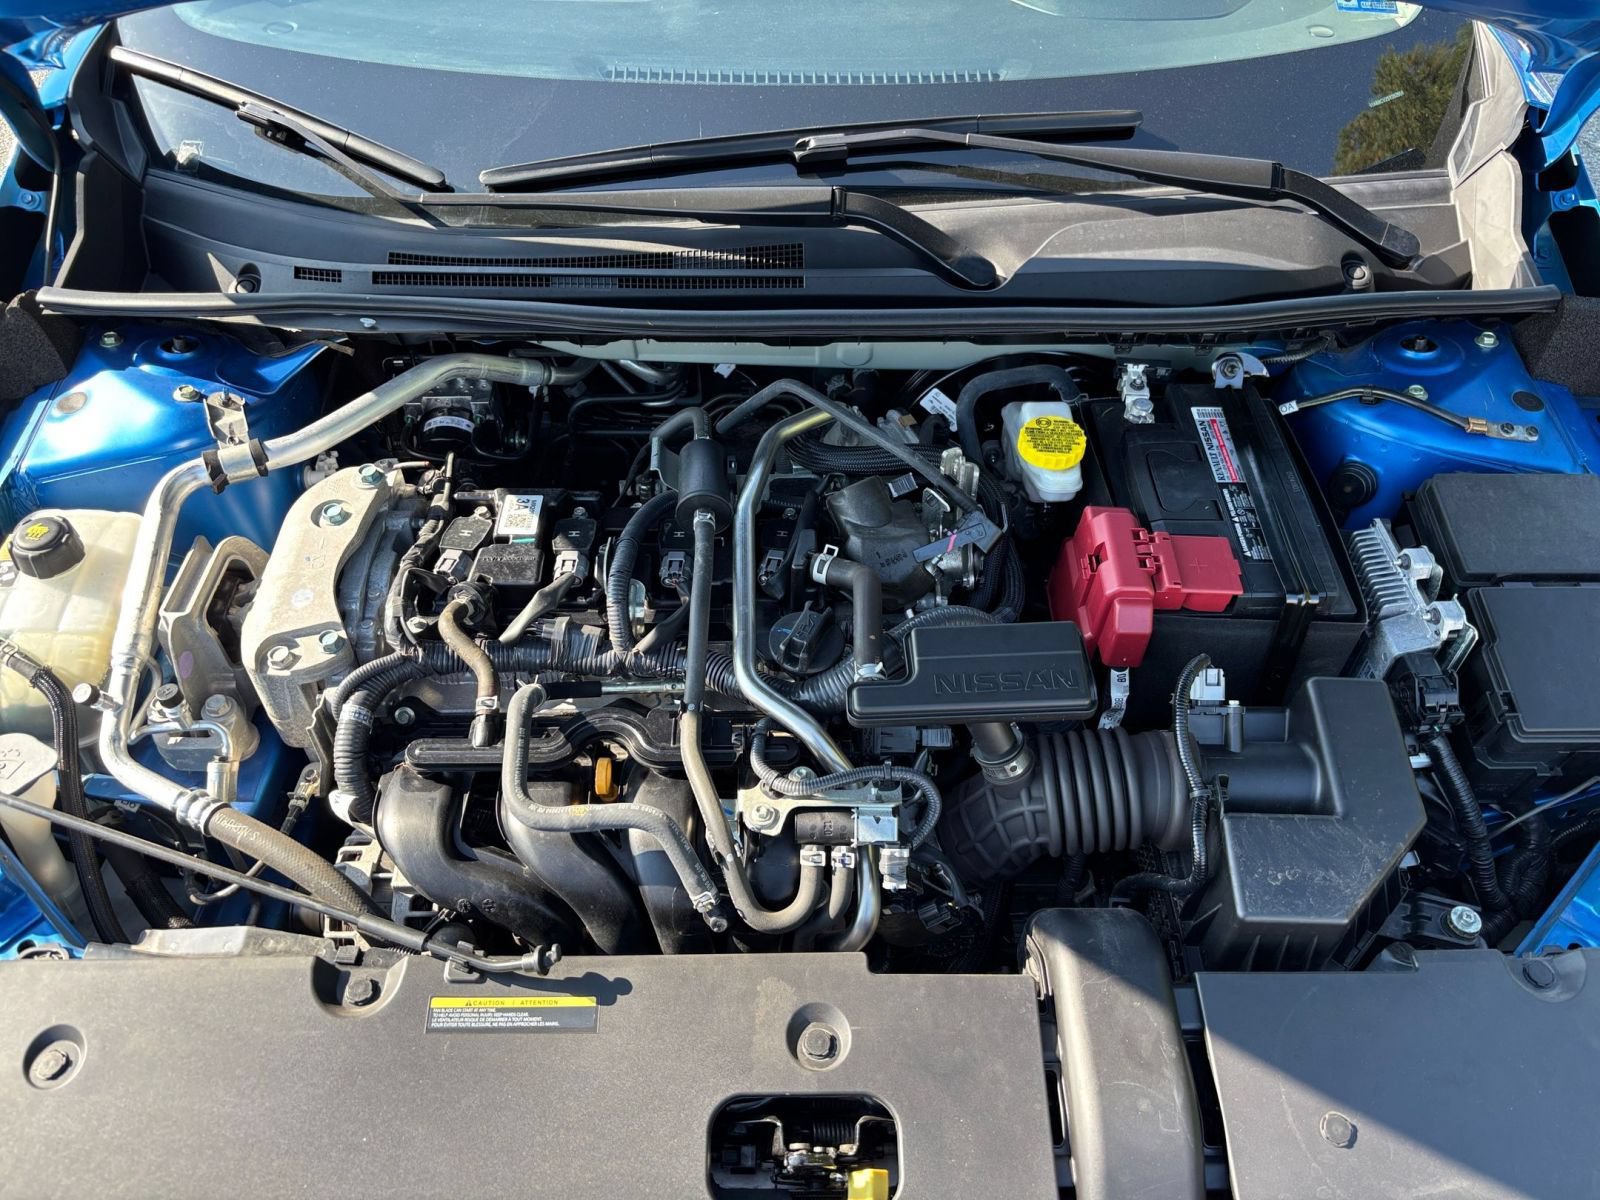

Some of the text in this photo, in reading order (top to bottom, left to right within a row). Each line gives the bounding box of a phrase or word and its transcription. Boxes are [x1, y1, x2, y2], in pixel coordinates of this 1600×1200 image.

[1198, 420, 1214, 450] NISSAN
[515, 498, 530, 511] 3A
[932, 668, 1078, 694] NISSAN
